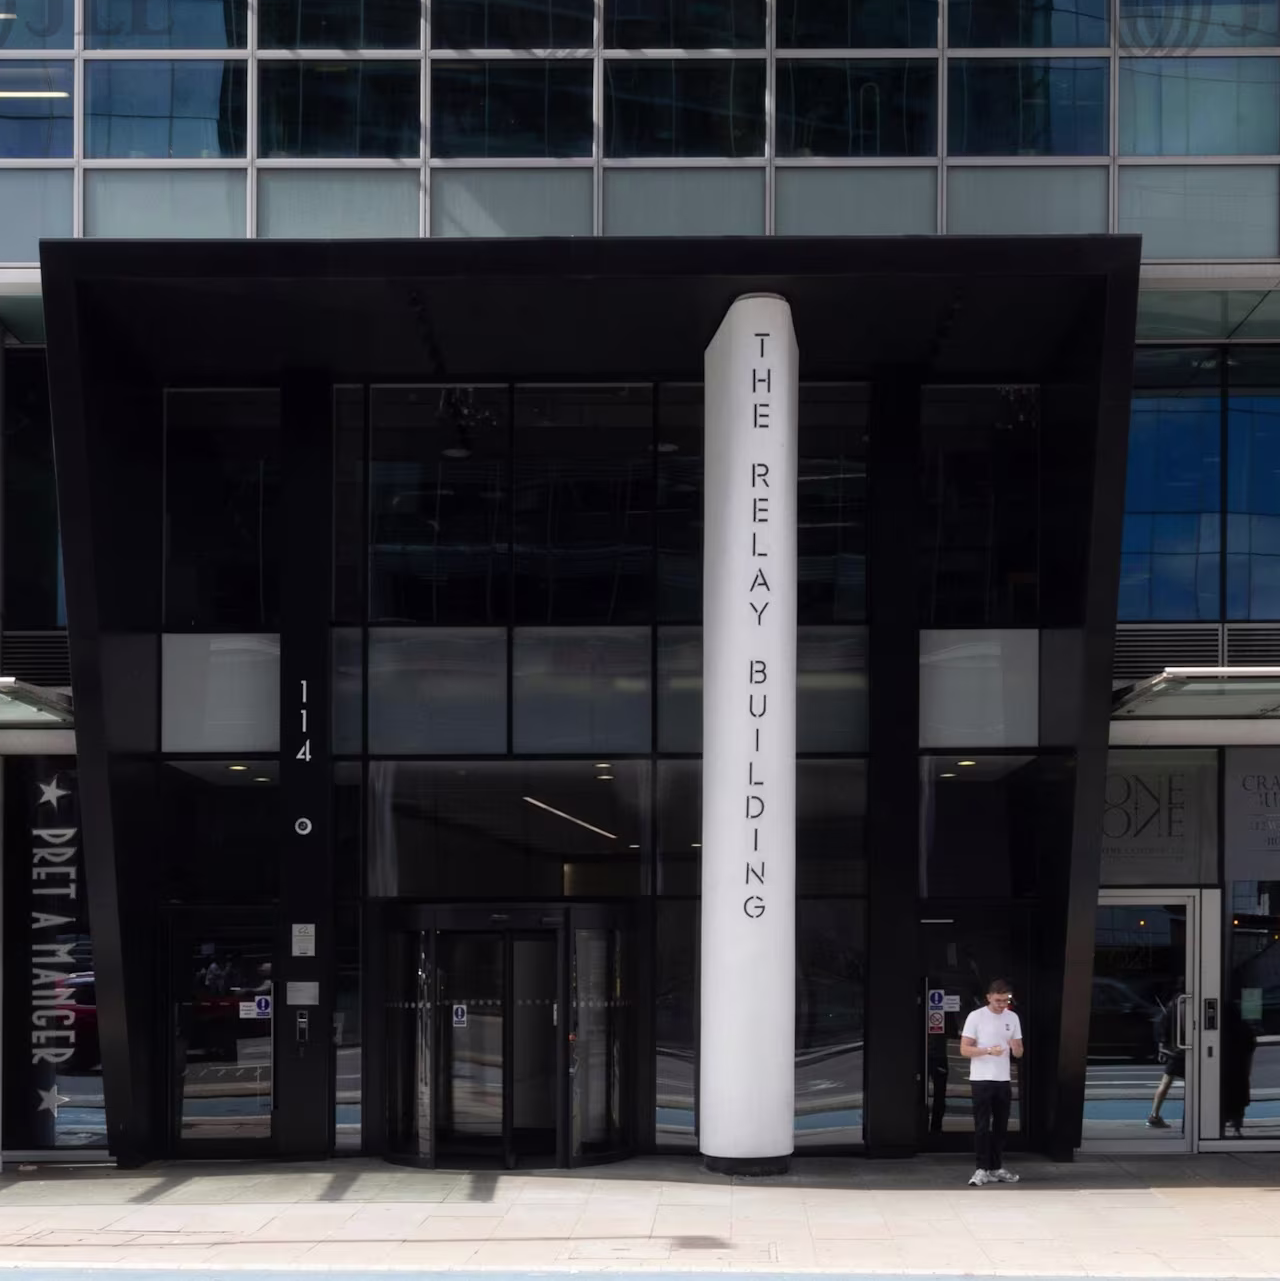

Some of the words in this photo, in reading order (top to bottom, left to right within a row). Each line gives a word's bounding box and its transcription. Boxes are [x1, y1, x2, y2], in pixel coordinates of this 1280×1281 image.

[753, 333, 771, 428] THE
[750, 463, 771, 626] RELAY
[743, 660, 768, 919] BUILDING
[32, 827, 78, 900] PRET
[32, 911, 77, 930] A
[32, 943, 77, 1064] MANGER
